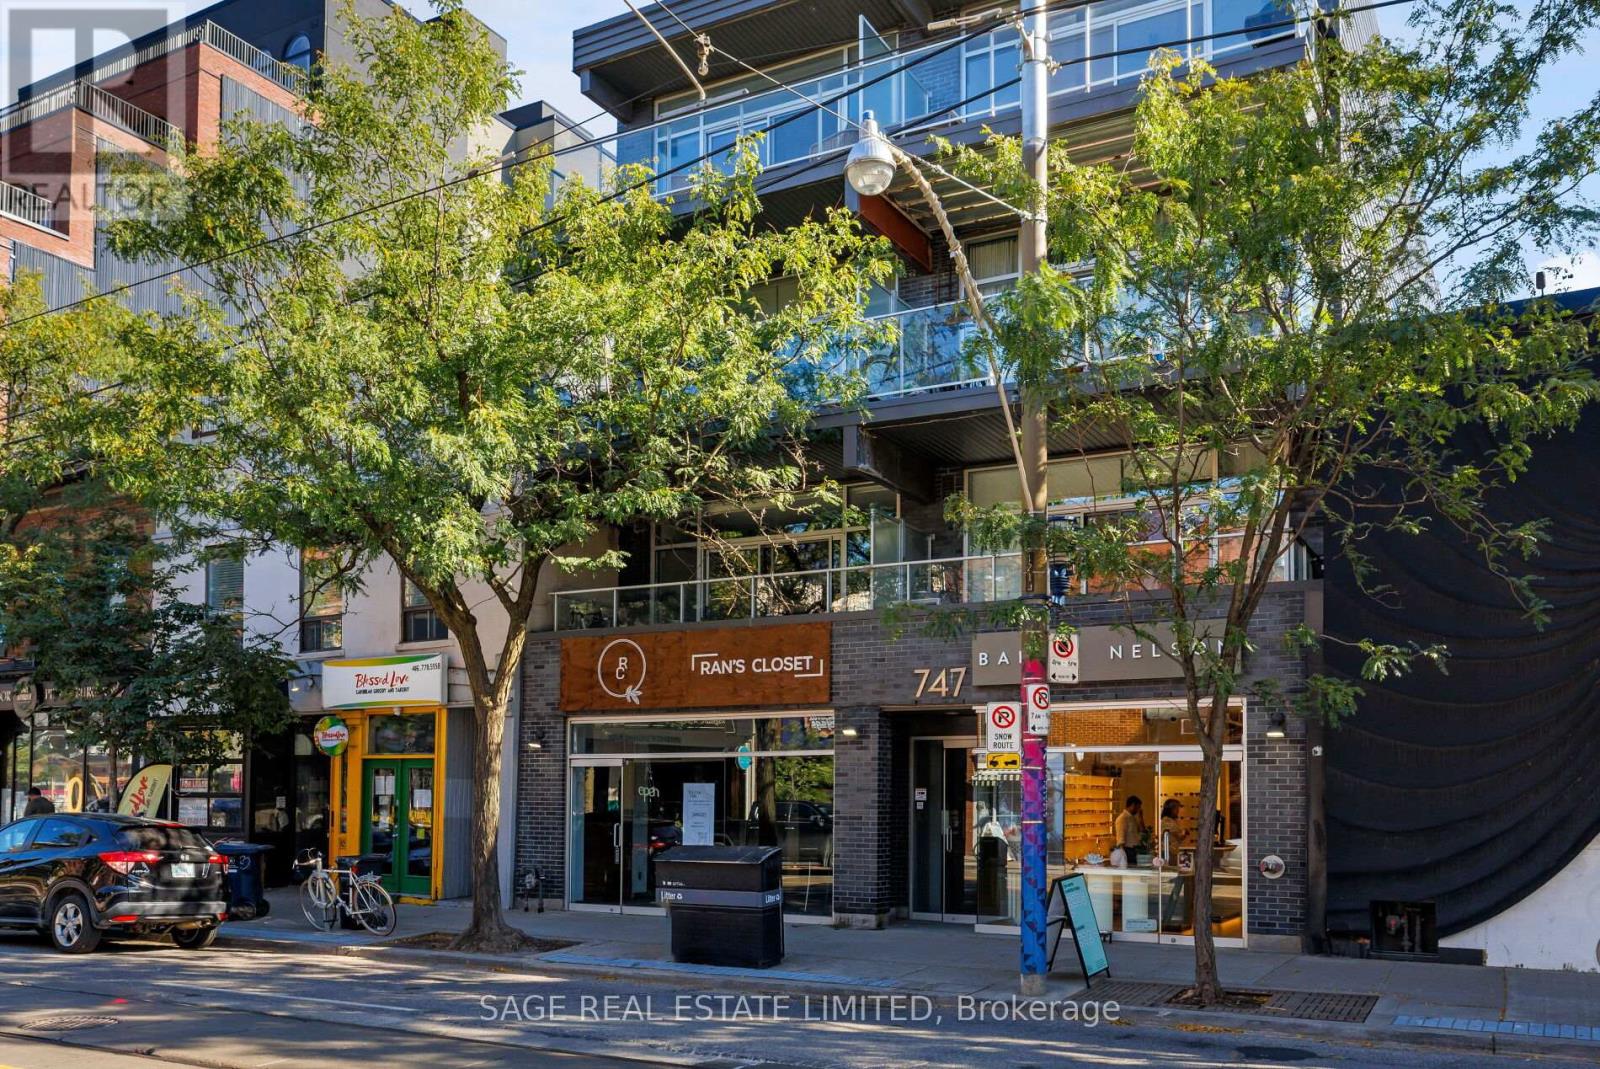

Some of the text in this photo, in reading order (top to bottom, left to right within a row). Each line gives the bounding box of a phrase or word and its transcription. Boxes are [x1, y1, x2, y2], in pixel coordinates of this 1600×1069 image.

[700, 655, 813, 676] RAN'S CLOSET
[913, 667, 967, 698] 747
[994, 733, 1012, 741] SNOW
[993, 741, 1014, 749] ROUTE
